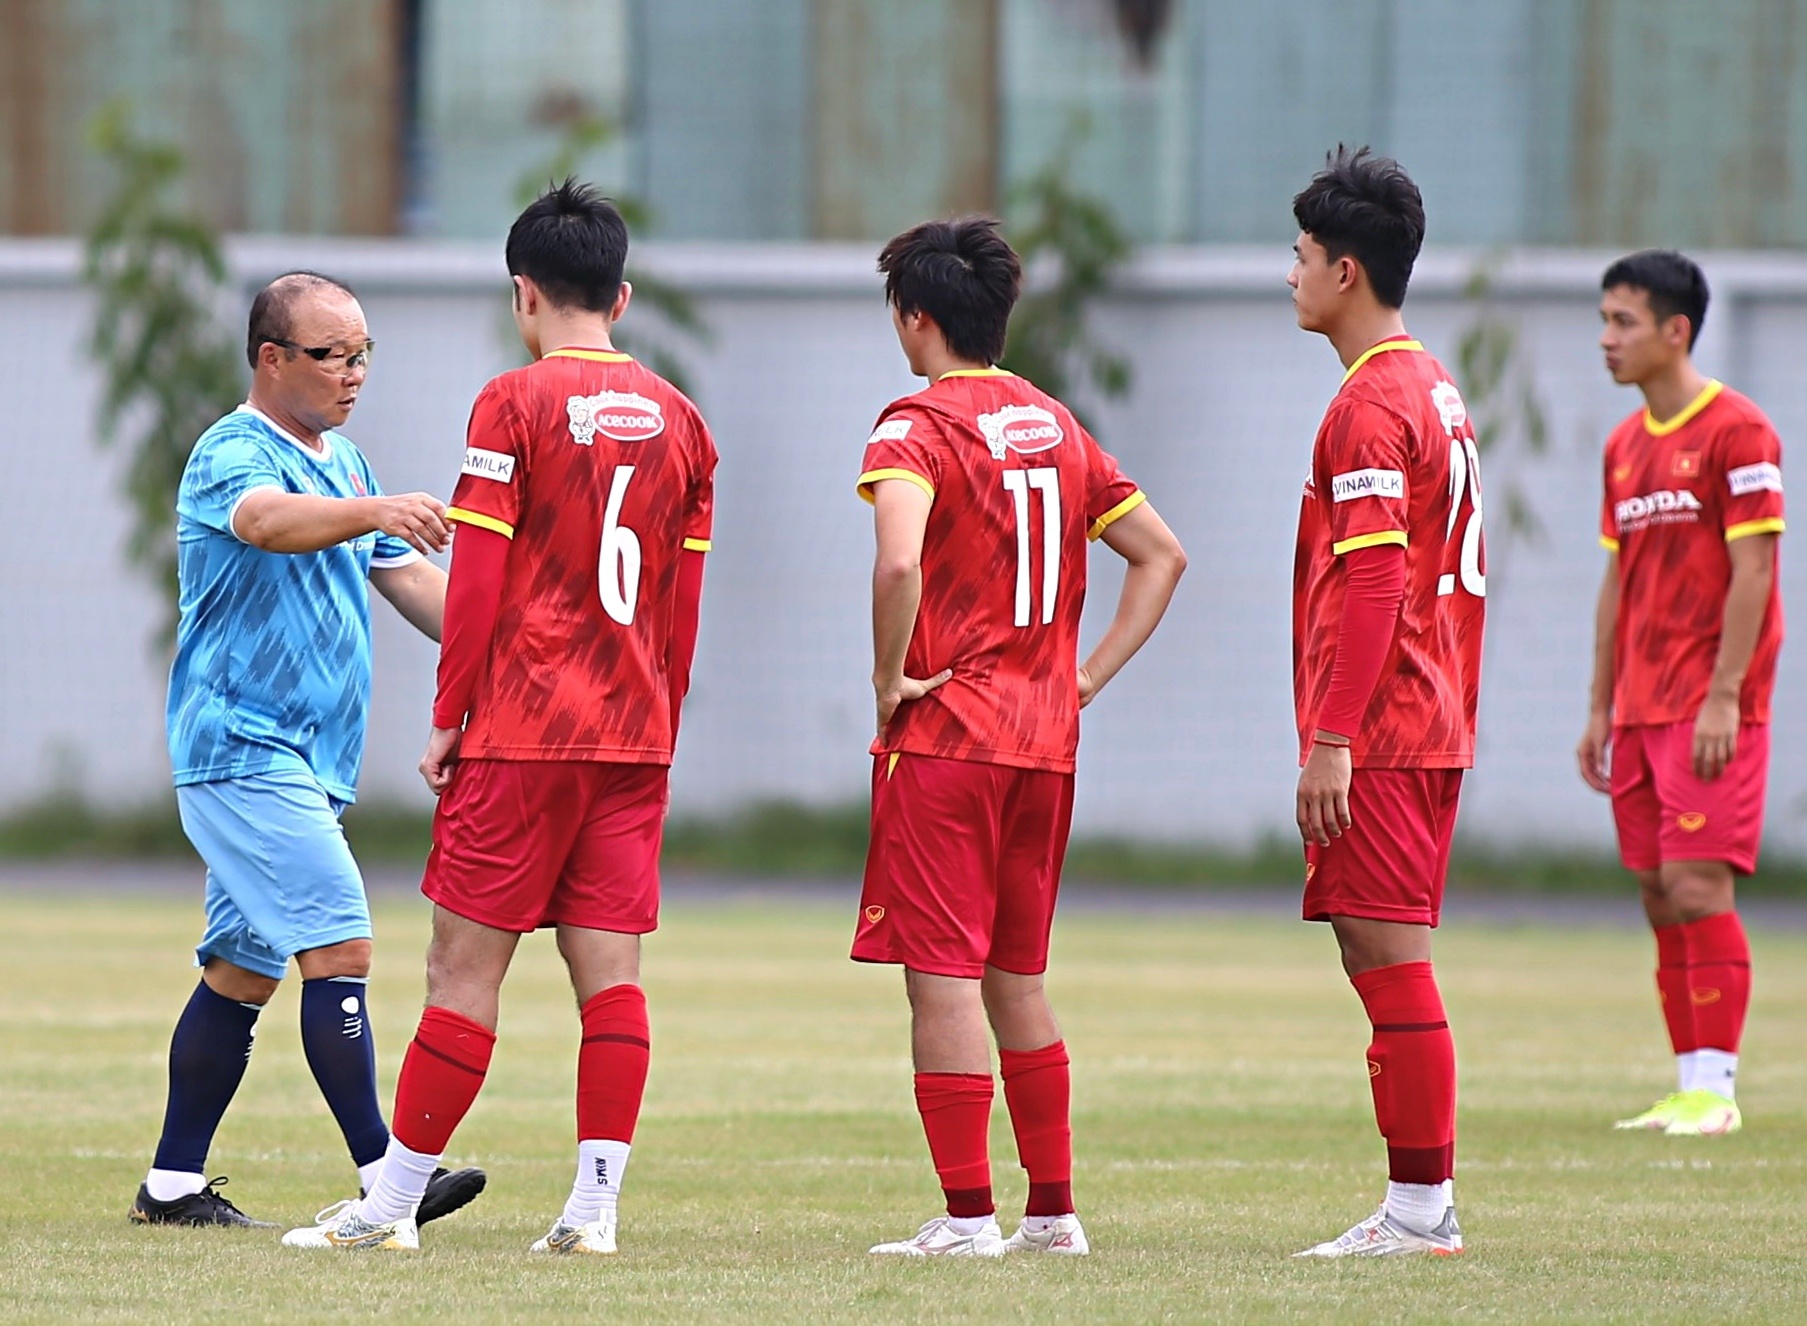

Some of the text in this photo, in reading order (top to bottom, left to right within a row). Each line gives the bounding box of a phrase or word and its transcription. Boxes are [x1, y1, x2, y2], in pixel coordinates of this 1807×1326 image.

[598, 464, 642, 627] 6
[1002, 466, 1062, 627] 11
[1334, 475, 1400, 495] VINAMILK
